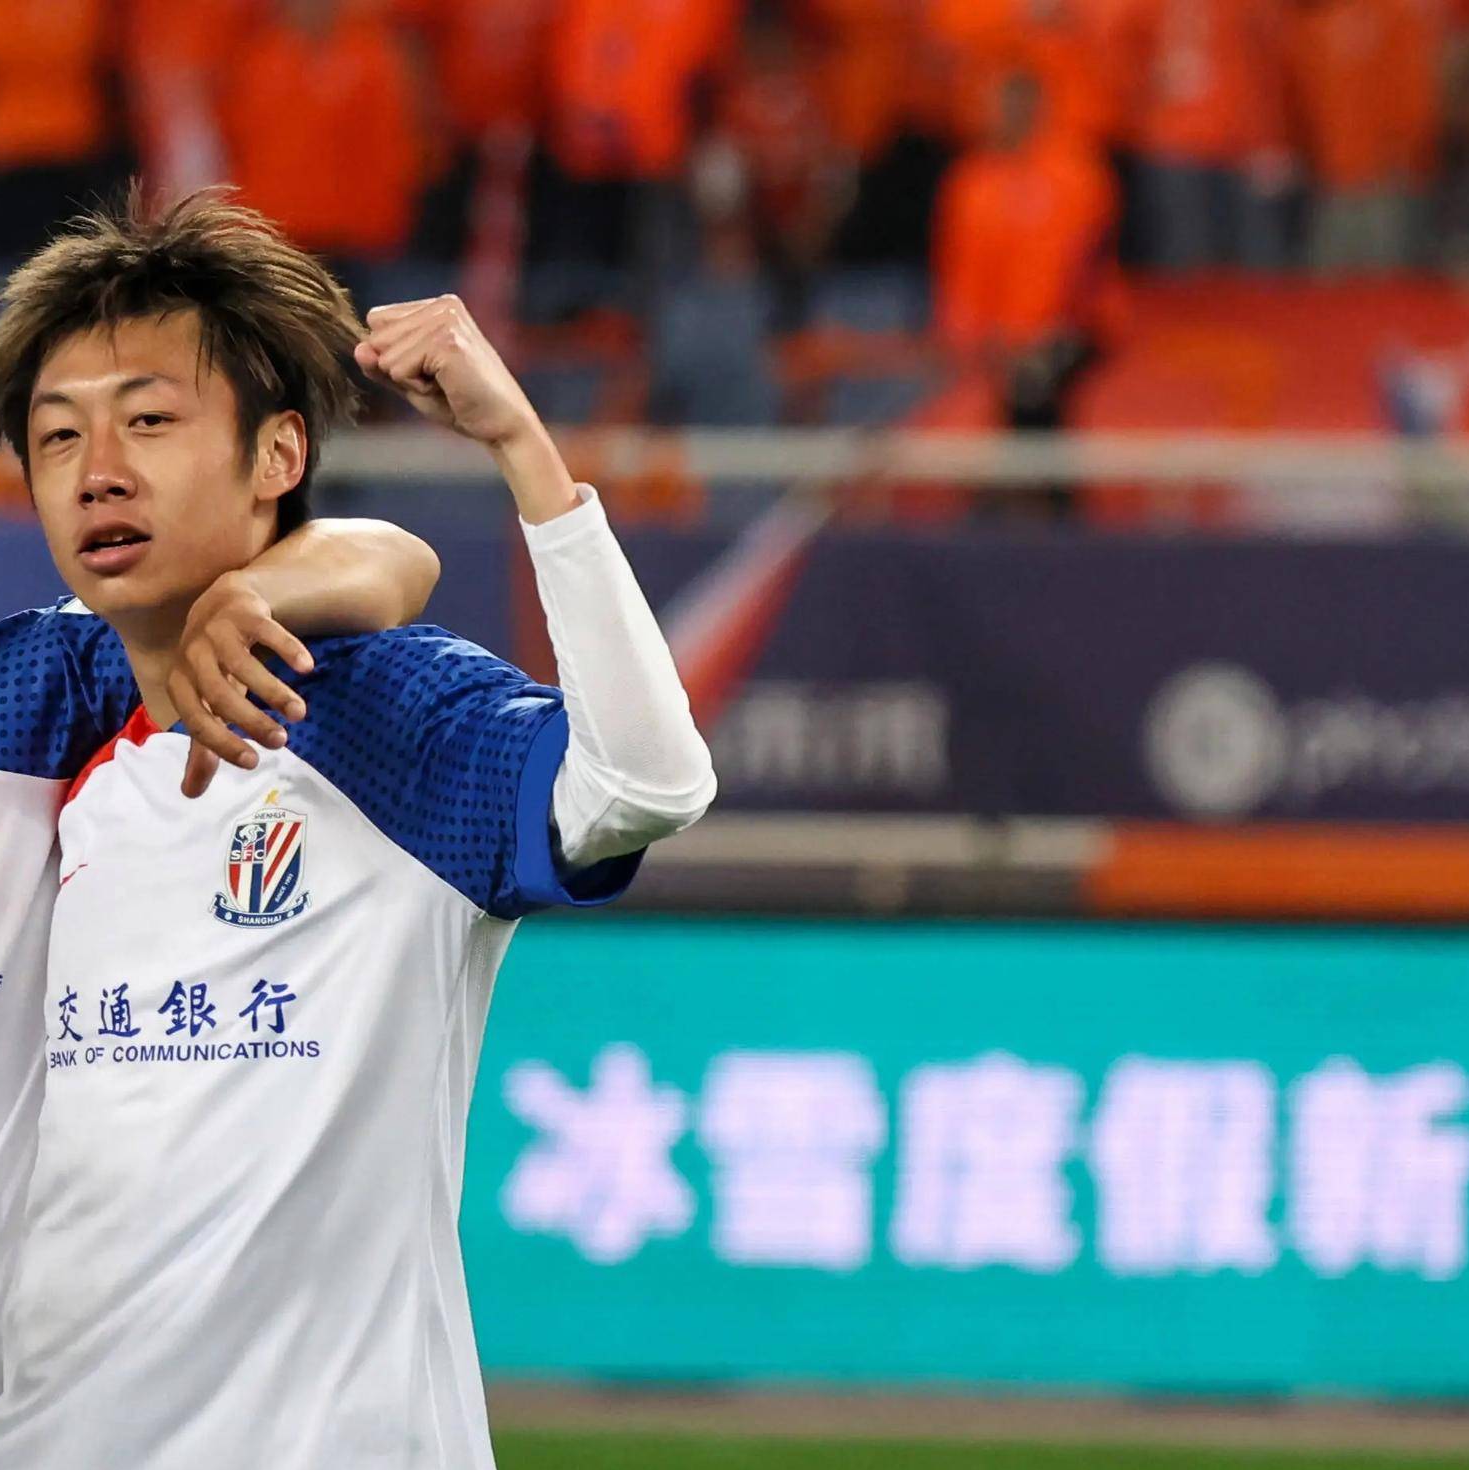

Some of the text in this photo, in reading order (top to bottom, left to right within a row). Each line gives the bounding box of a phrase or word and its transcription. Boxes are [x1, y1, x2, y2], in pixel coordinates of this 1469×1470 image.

[230, 849, 265, 861] SFC
[237, 915, 282, 925] SHANGHAI
[58, 978, 297, 1042] 交通銀行
[50, 1040, 320, 1069] BANK OF COMMUNICATIONS
